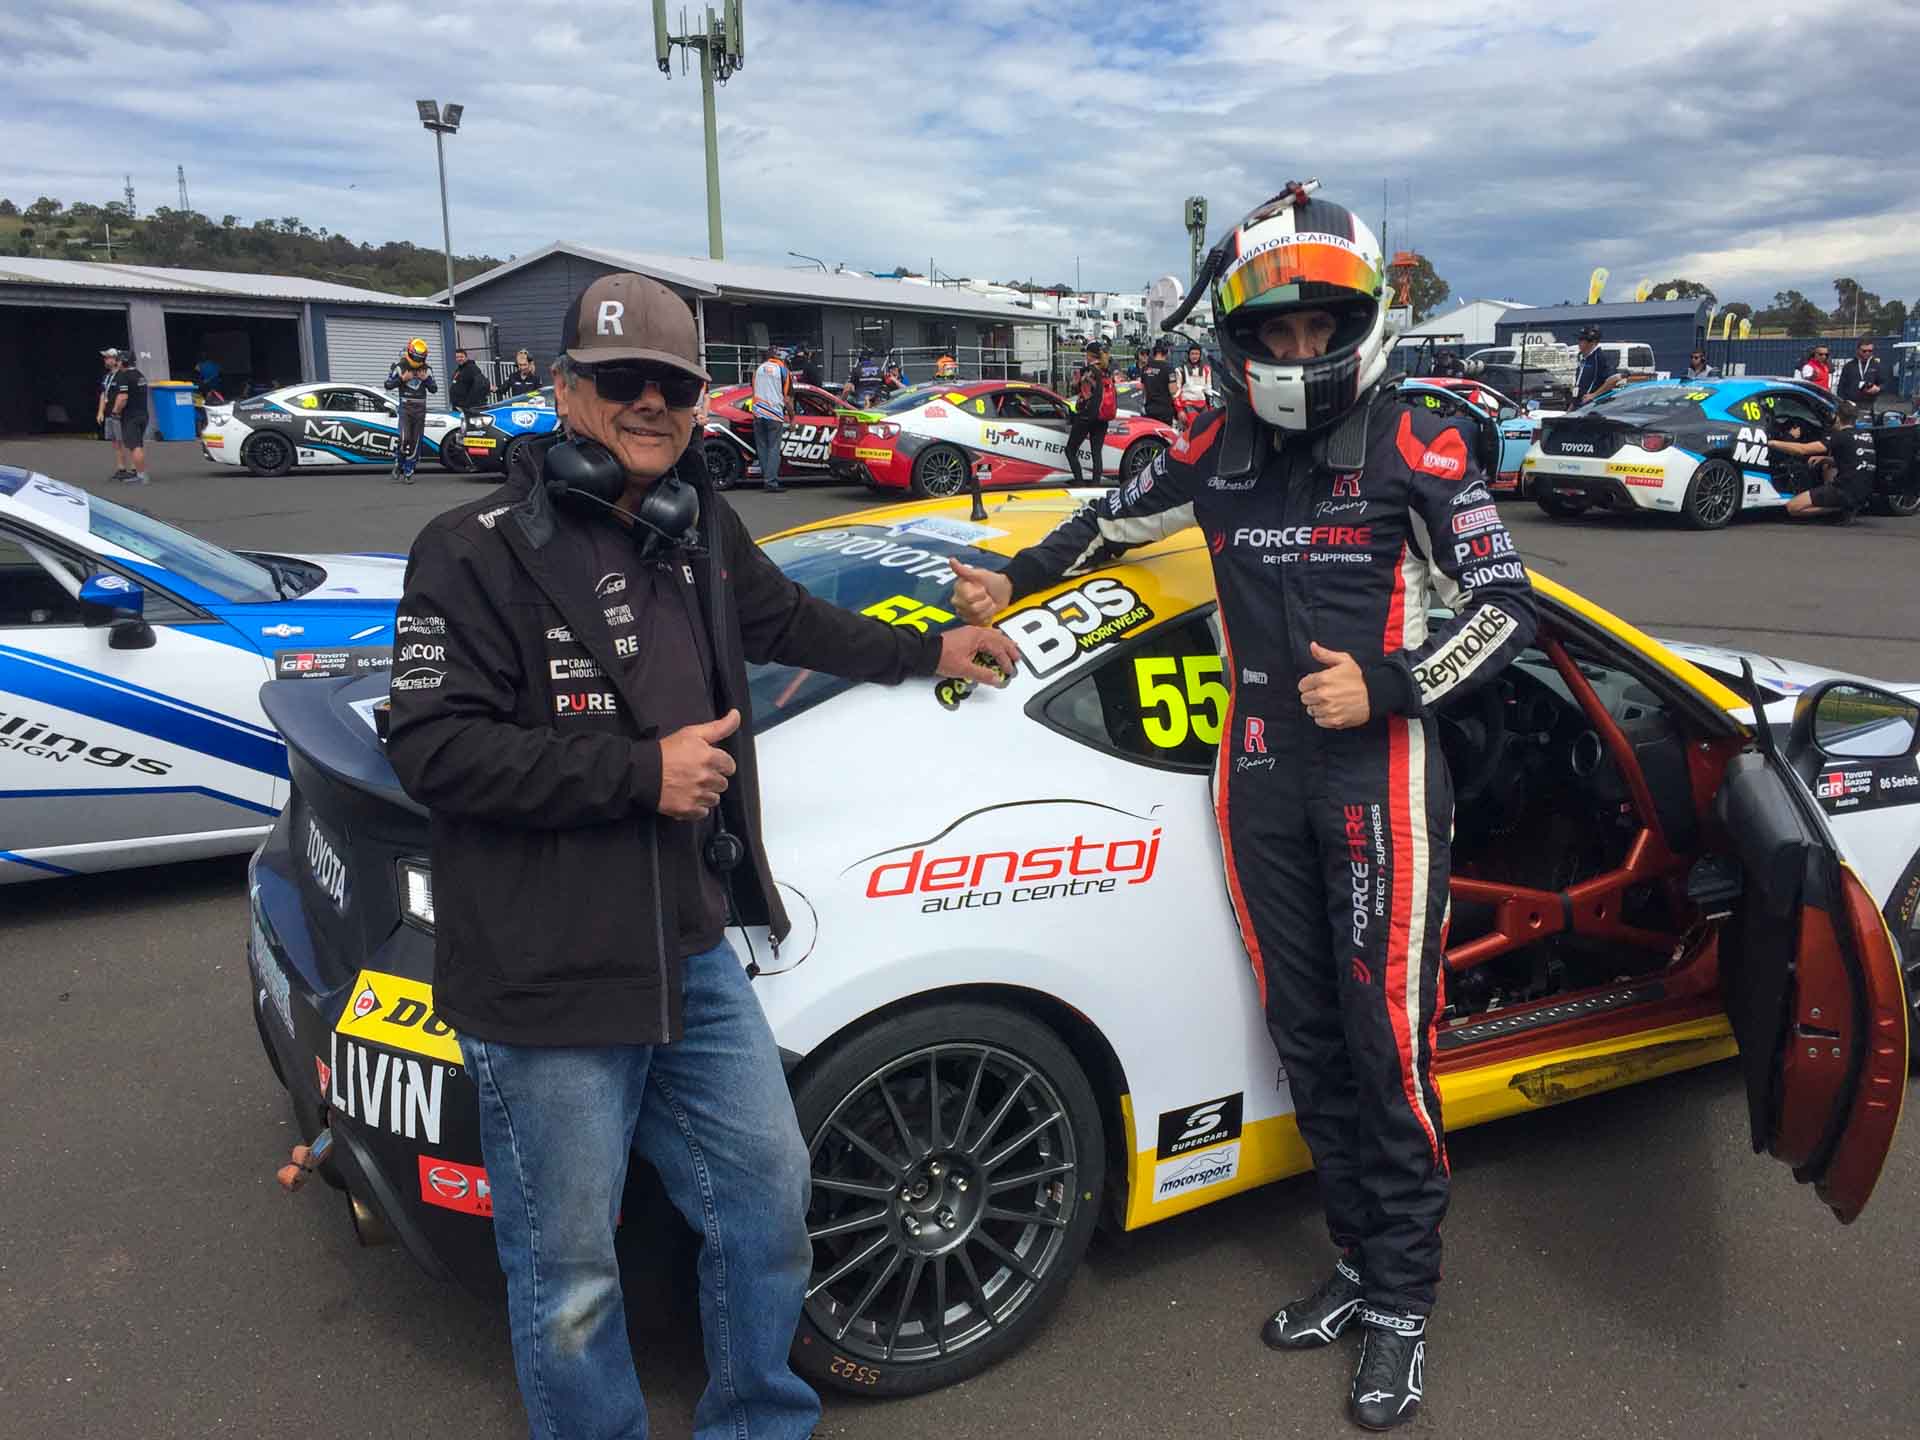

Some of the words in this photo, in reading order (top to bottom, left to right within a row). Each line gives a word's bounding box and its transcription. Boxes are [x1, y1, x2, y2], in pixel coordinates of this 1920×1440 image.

[1237, 235, 1291, 266] AVIATOR
[1295, 233, 1352, 249] CAPITAL
[596, 300, 625, 336] R
[1742, 400, 1761, 421] 16
[1002, 435, 1043, 450] PLANT
[1560, 442, 1595, 454] TOYOTA
[1331, 470, 1364, 497] R
[1614, 464, 1664, 475] DUNLOP
[1316, 500, 1369, 518] Racing
[1233, 526, 1373, 548] FORCEFIRE
[1453, 532, 1516, 564] PURE
[825, 534, 958, 586] TOYOTA
[1262, 552, 1301, 565] DETECT
[1309, 552, 1373, 563] SUPPRESS
[998, 578, 1136, 675] BJS
[1078, 606, 1149, 649] WORKWEAR
[283, 659, 312, 671] GR
[357, 658, 370, 668] 86
[371, 657, 394, 667] Serie
[1411, 607, 1509, 695] Reynolds
[555, 692, 617, 713] PURE
[1133, 654, 1231, 749] 55
[1243, 716, 1268, 753] R
[1236, 756, 1276, 773] Racing
[1843, 770, 1873, 780] TOYOTA
[1818, 783, 1844, 797] GR
[1879, 777, 1892, 789] 86
[1891, 774, 1919, 789] Series
[1370, 803, 1387, 865] SUPPRESS
[306, 818, 346, 910] TOYOTA
[865, 827, 1163, 899] denstoj
[1343, 802, 1370, 948] FORCEFIRE
[921, 889, 1002, 914] auto
[1010, 877, 1116, 904] centre
[1374, 877, 1386, 917] DETECT
[331, 1031, 444, 1145] LIVIN
[1170, 1129, 1230, 1153] SUPERCARS
[1159, 1163, 1233, 1194] motorsport
[830, 1355, 881, 1385] 5582
